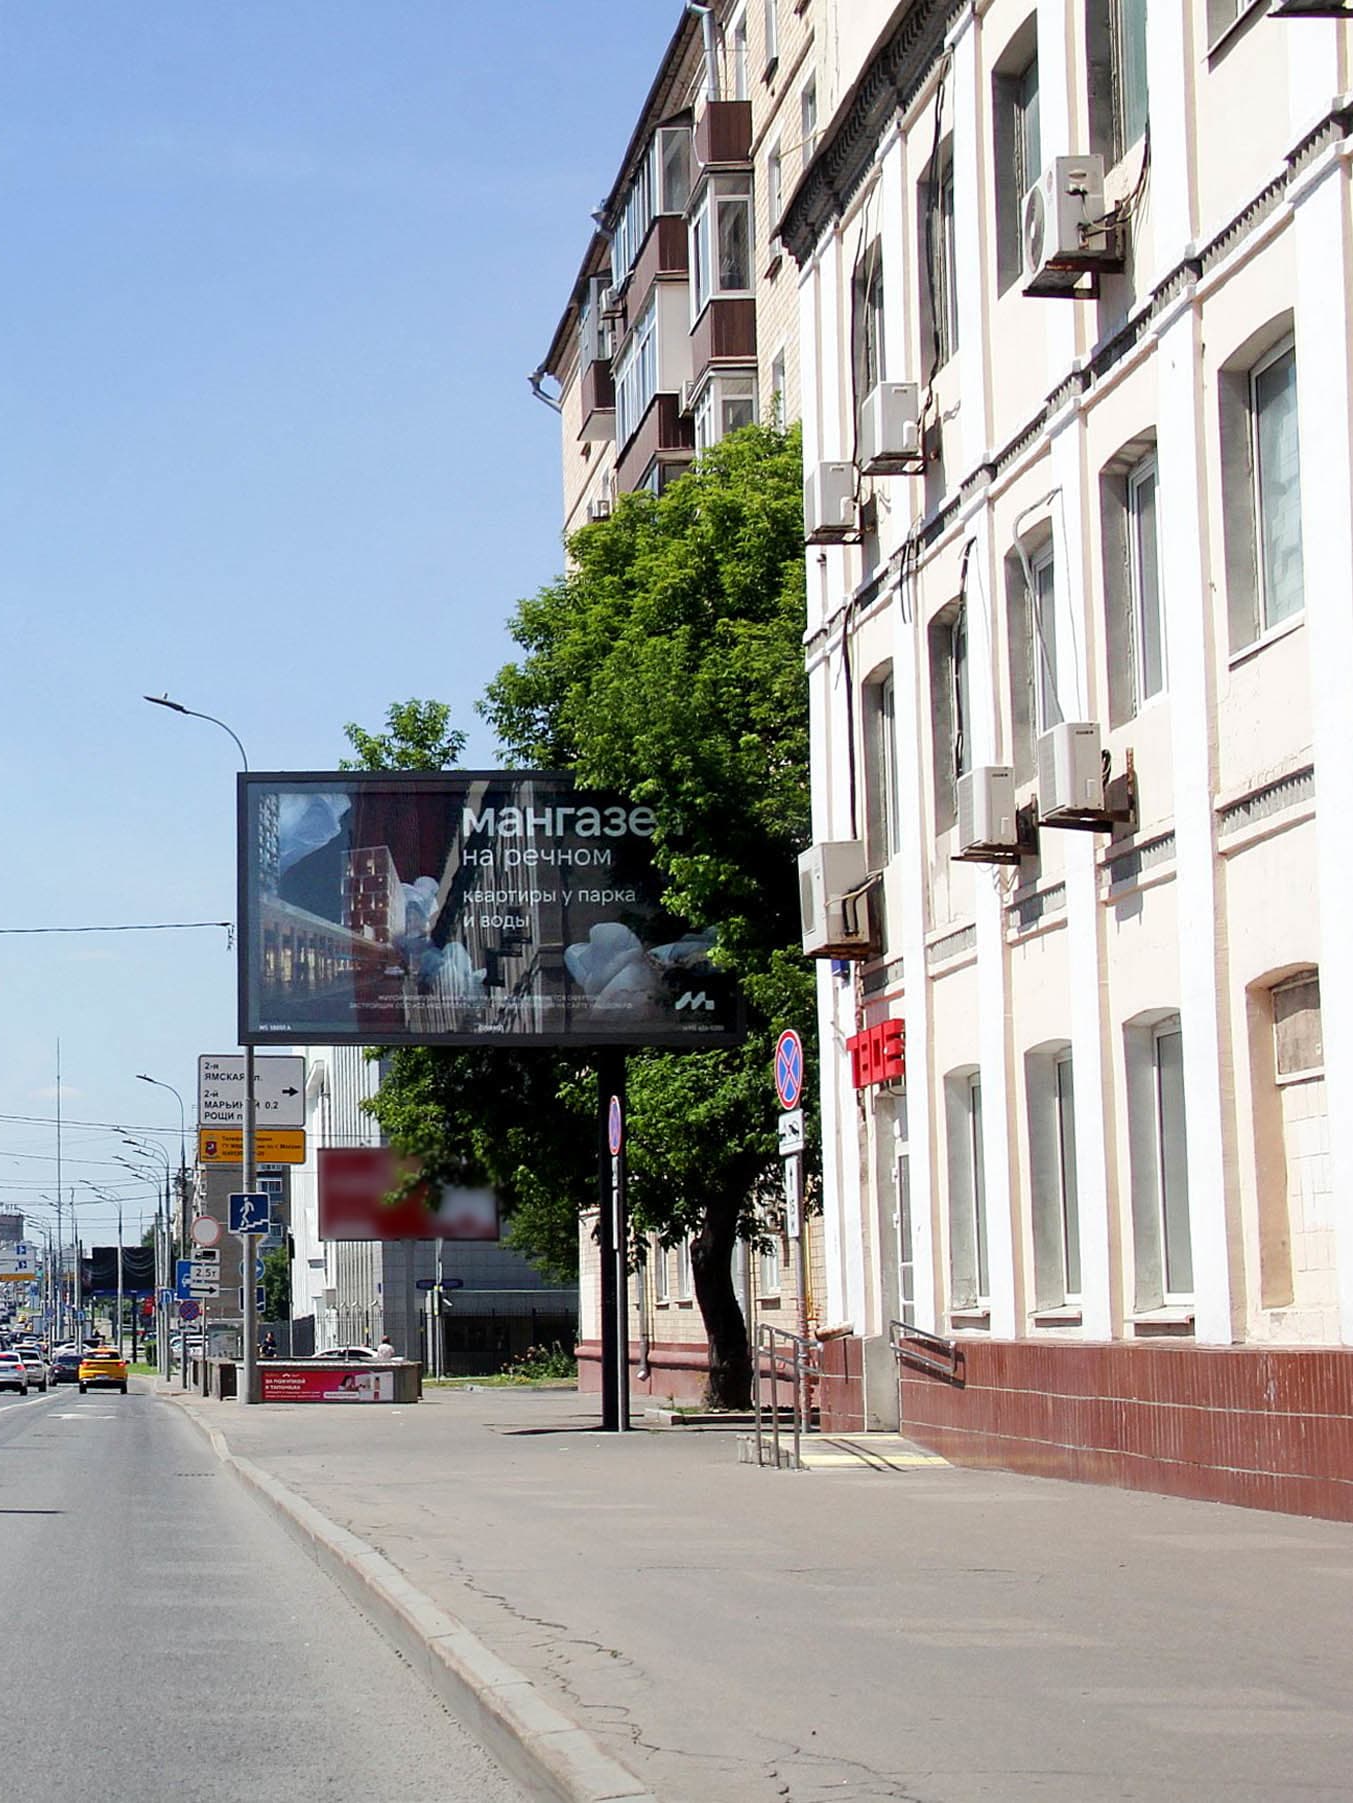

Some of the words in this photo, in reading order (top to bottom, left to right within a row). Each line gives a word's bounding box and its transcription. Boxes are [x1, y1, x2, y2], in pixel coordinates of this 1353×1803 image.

[462, 805, 684, 838] мангазе
[462, 849, 494, 867] на
[505, 849, 612, 873] речном
[463, 889, 557, 905] квартиры
[562, 890, 573, 906] у
[578, 889, 637, 905] парка
[463, 914, 475, 928] и
[480, 914, 530, 930] воды
[204, 1072, 246, 1081] ЯМСКАЯ
[204, 1112, 234, 1121] РОЩИ
